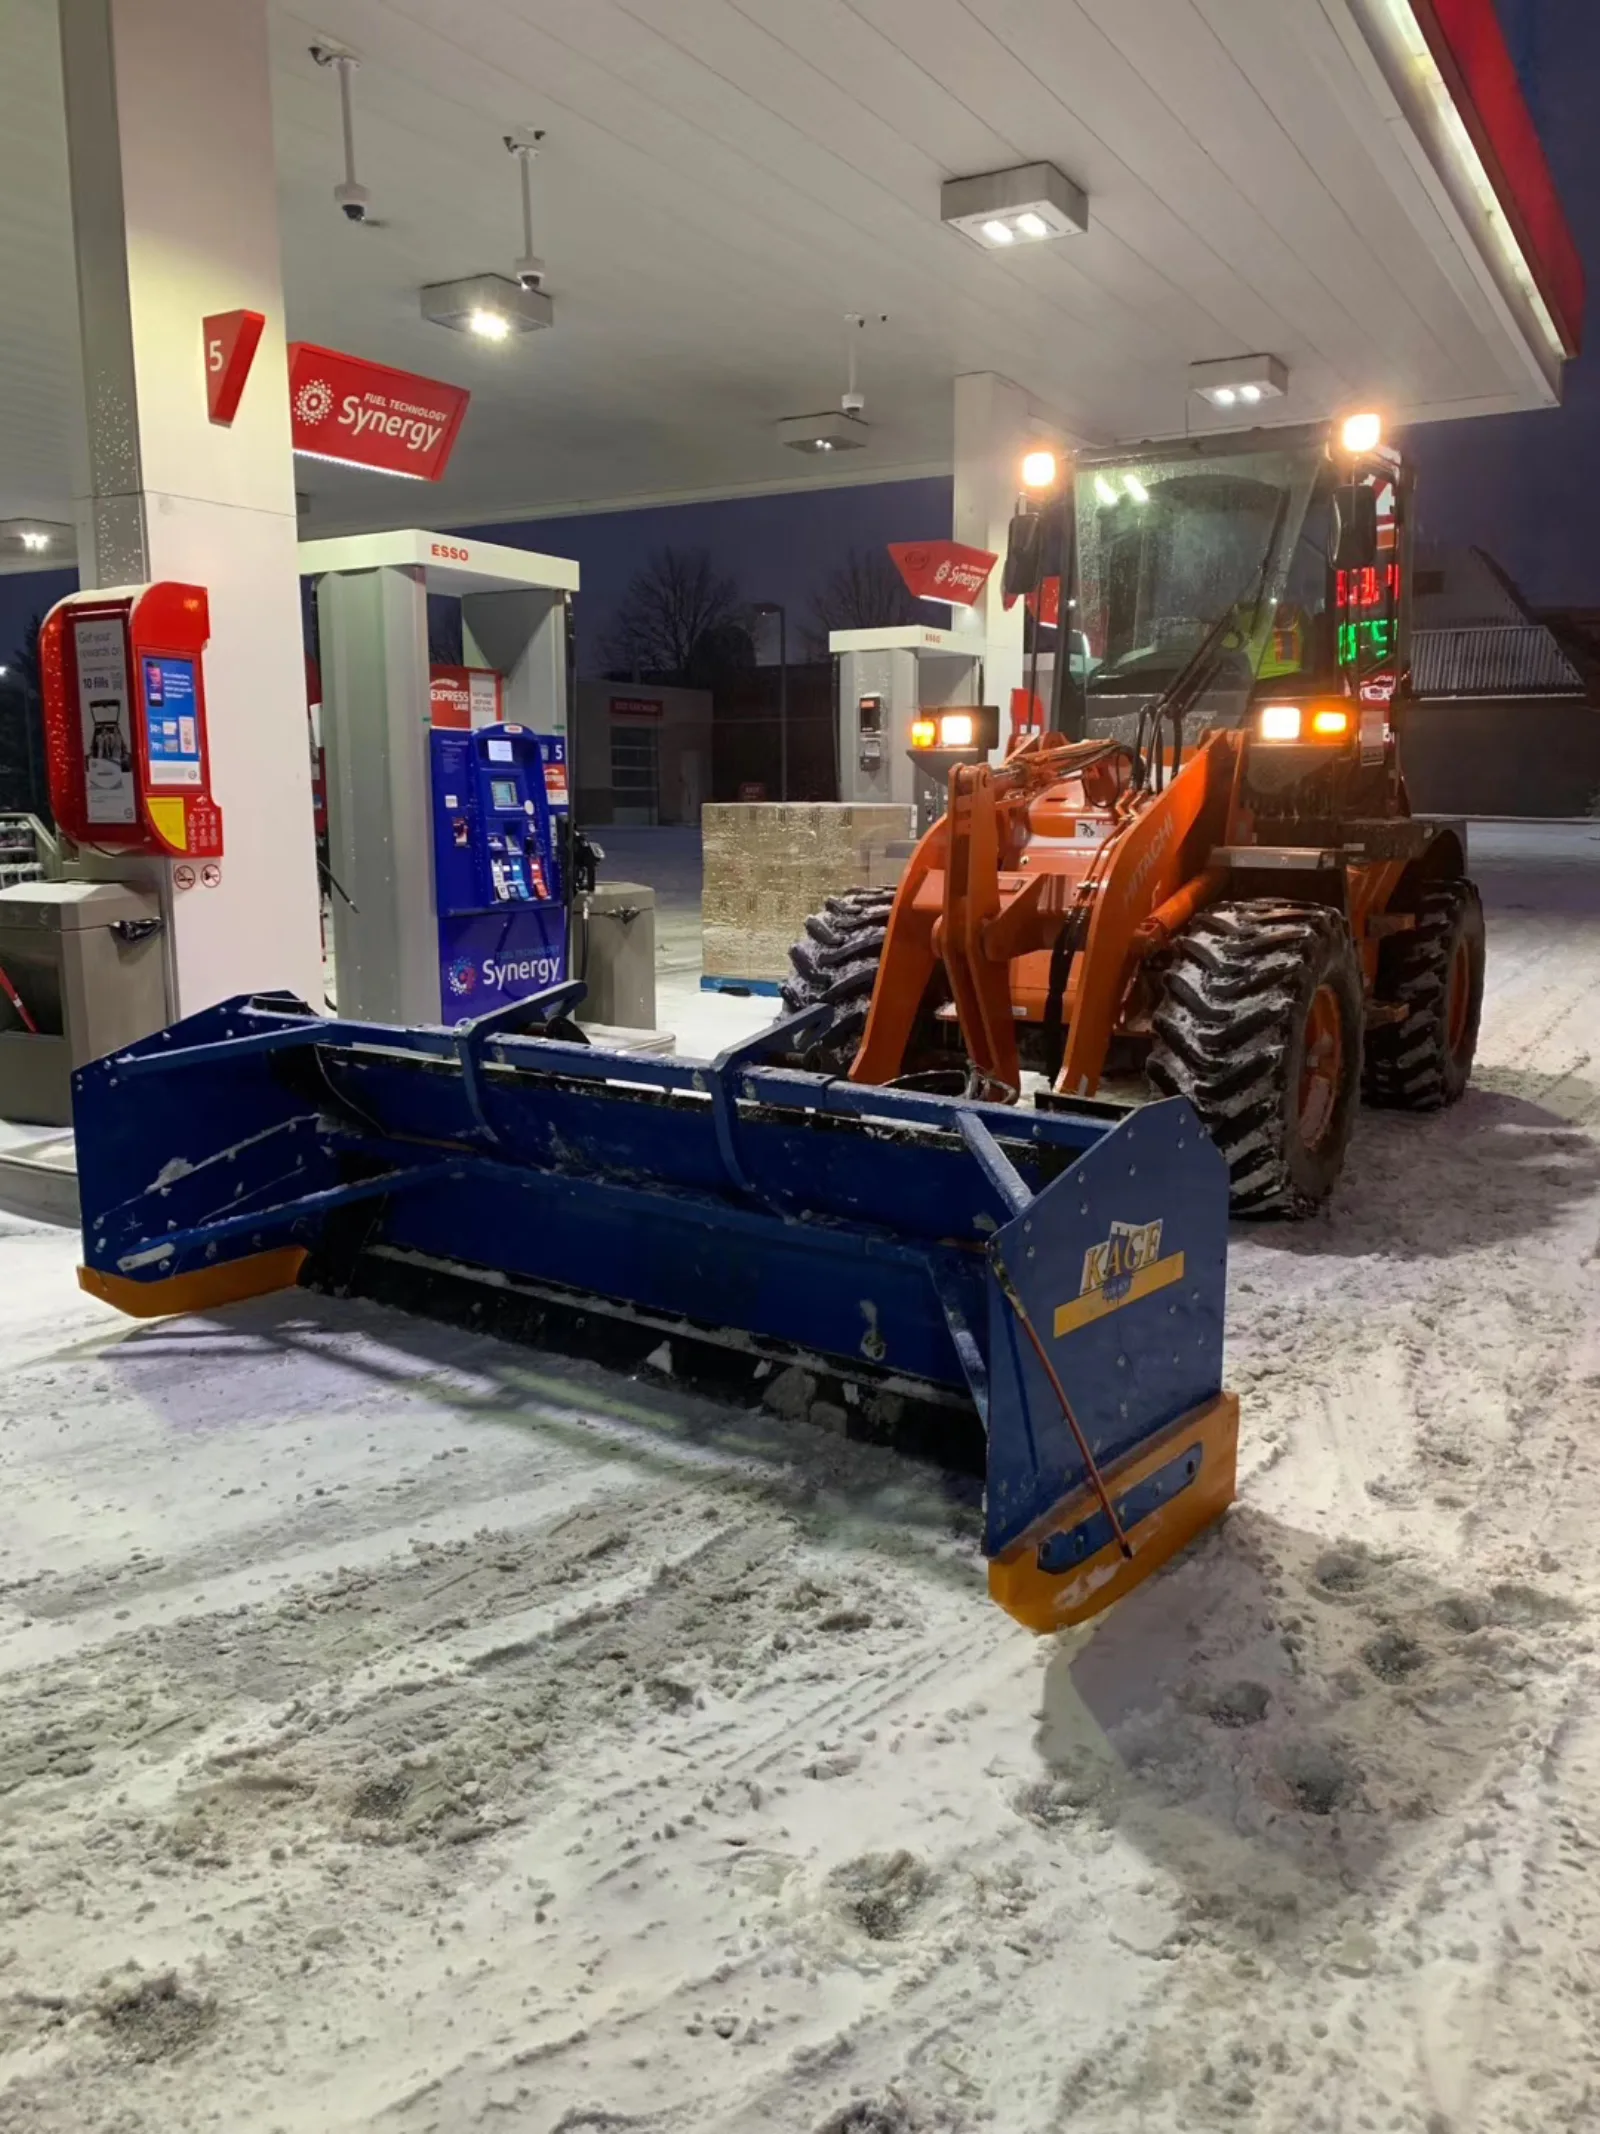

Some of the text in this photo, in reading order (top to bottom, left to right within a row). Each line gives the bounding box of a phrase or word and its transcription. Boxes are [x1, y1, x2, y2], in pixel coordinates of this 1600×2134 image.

[209, 339, 223, 372] 5
[363, 392, 448, 423] FUEL TECHNOLOGY
[337, 395, 442, 453] Synergy
[431, 543, 469, 562] ESSO
[947, 565, 985, 592] Synergy
[82, 677, 93, 689] 10
[430, 688, 469, 702] EXPRESS
[555, 744, 563, 760] 5
[482, 956, 561, 991] Synergy
[1082, 1221, 1162, 1294] KAGE
